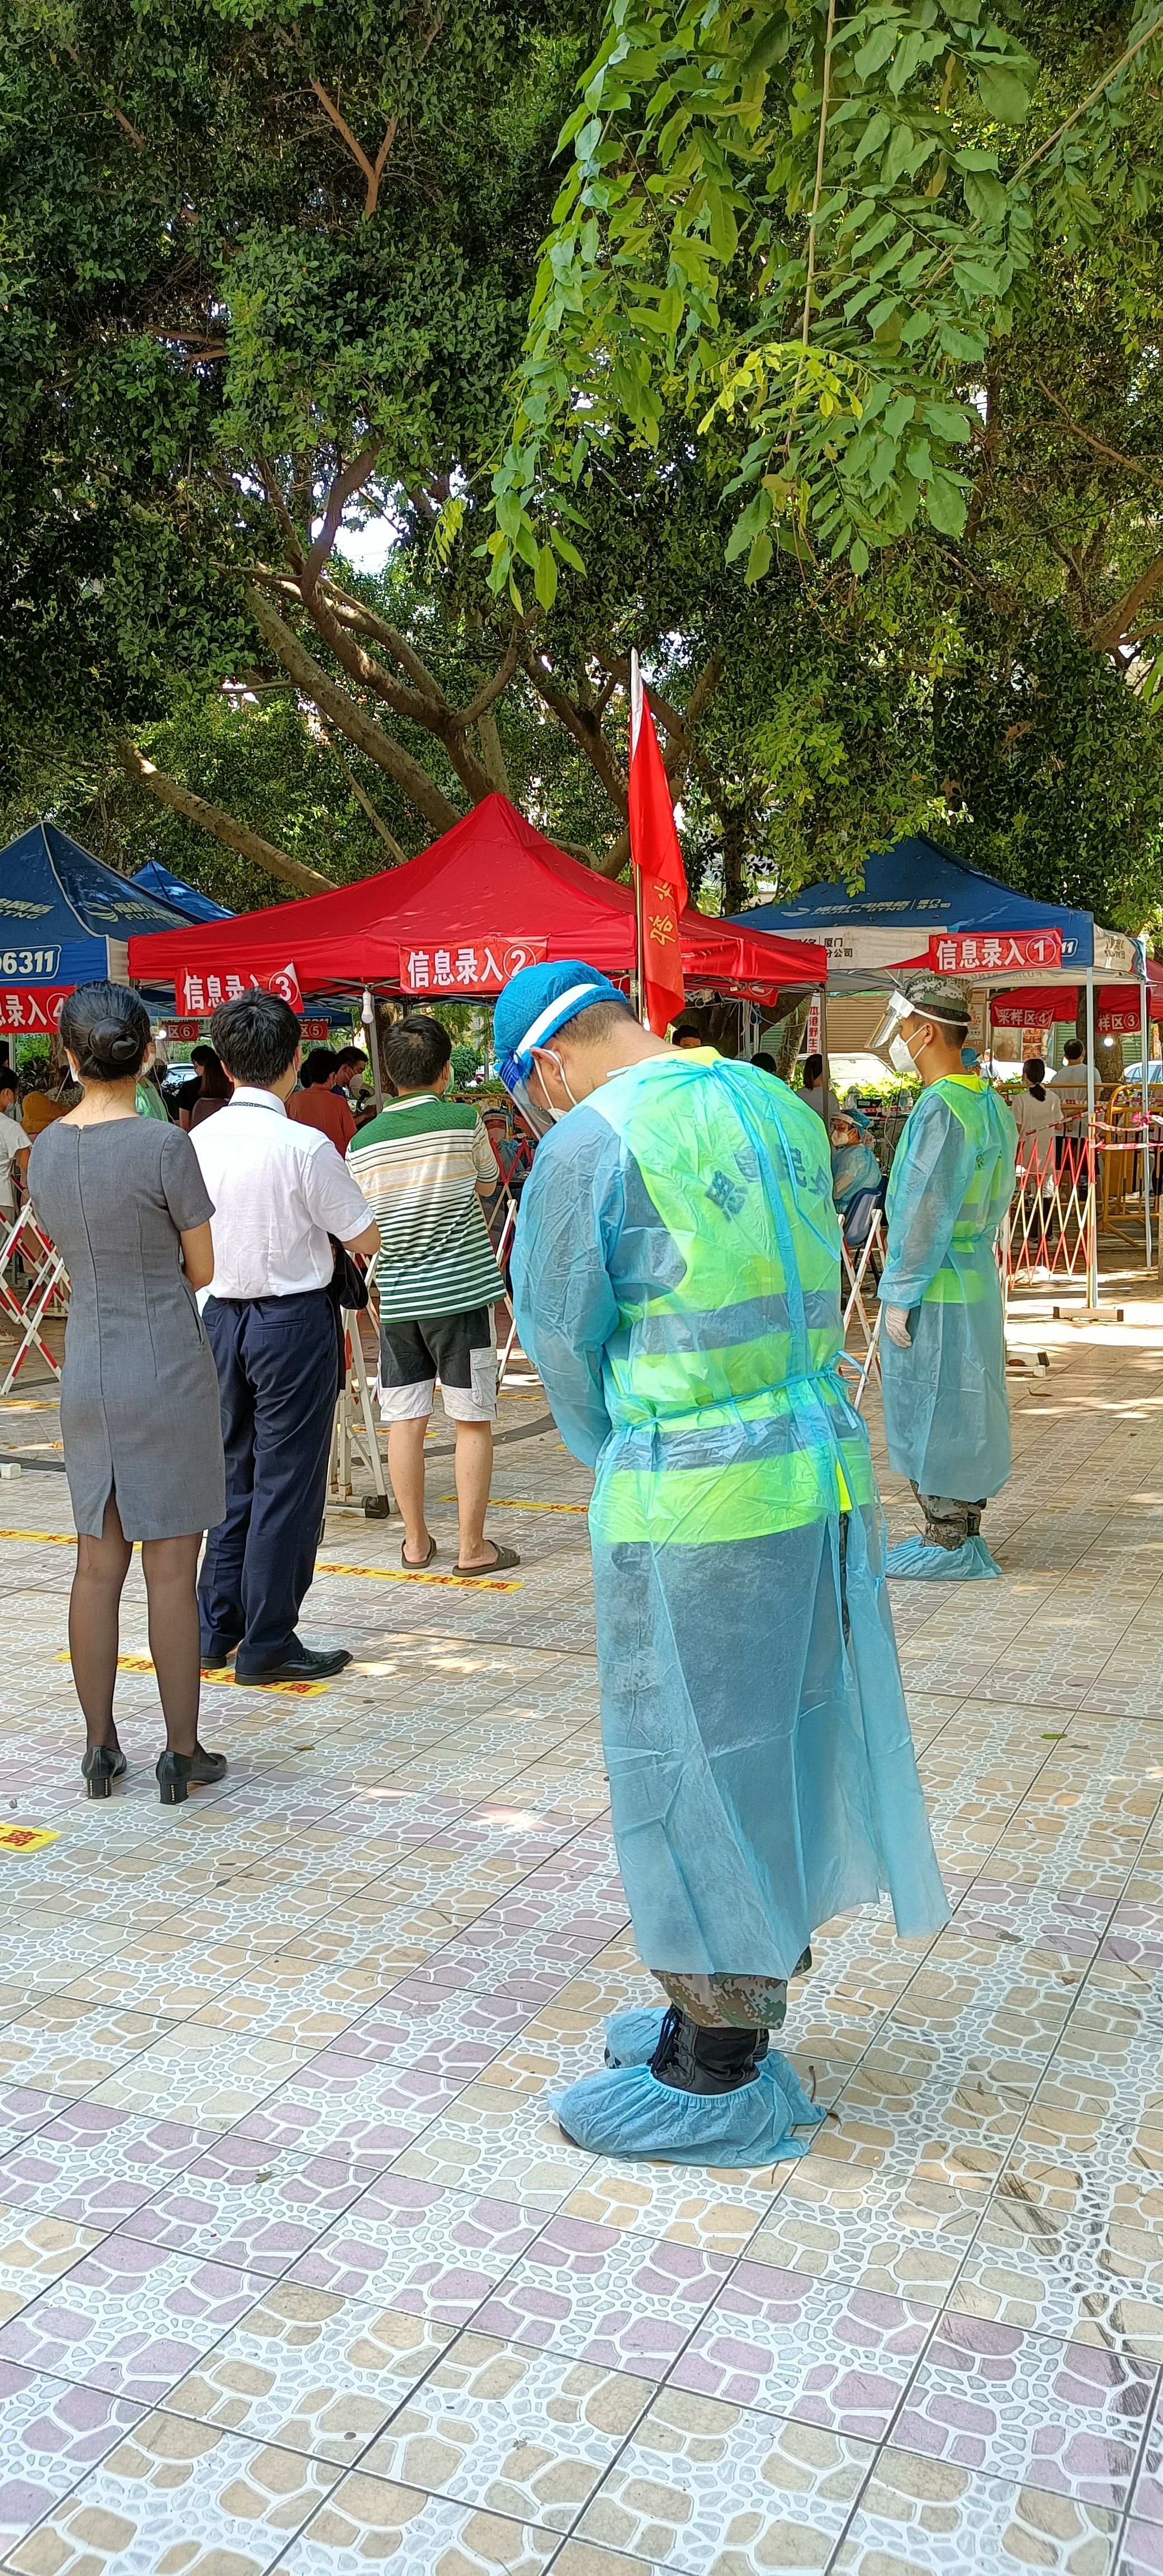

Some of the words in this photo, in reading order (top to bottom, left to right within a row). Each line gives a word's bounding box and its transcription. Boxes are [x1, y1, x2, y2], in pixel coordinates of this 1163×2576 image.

[824, 937, 843, 948] 厦门
[0, 950, 55, 974] 6311
[0, 993, 68, 1027] 录入④
[0, 1826, 44, 1846] 离
